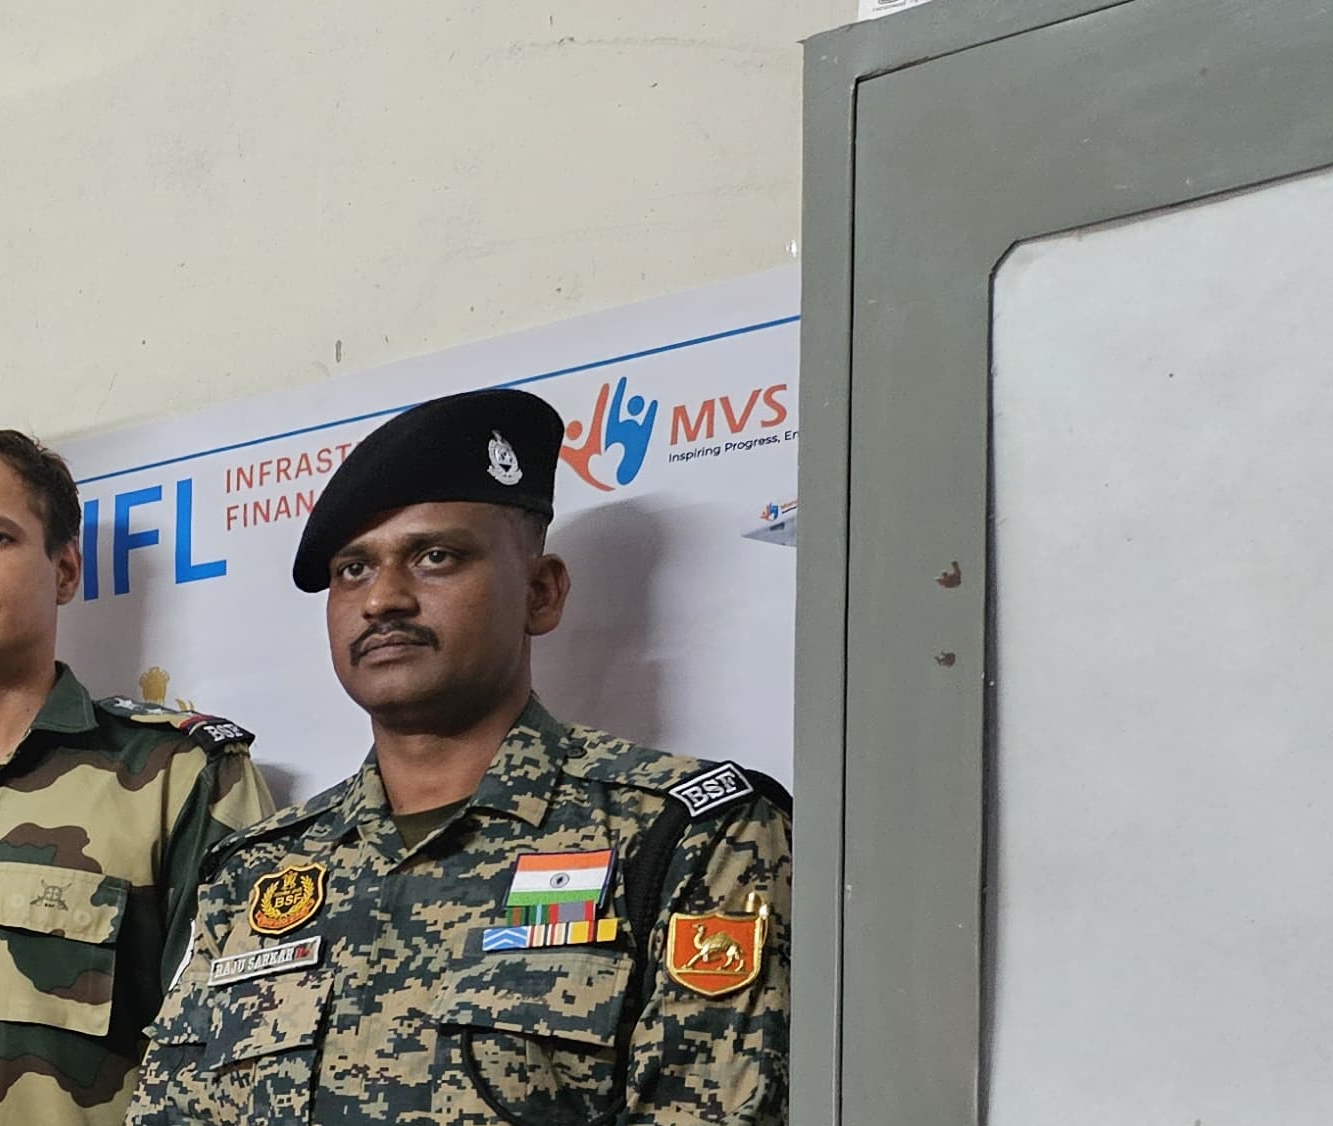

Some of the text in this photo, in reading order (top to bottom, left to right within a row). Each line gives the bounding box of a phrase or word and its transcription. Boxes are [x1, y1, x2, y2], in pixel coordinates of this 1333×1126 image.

[670, 383, 788, 446] MVS
[668, 445, 722, 464] Inspiring
[724, 433, 782, 453] Progress,
[83, 477, 227, 602] IFL
[203, 722, 244, 741] BSF
[680, 770, 737, 808] BSF
[274, 892, 302, 908] BSF
[214, 961, 245, 978] RAJU
[247, 947, 295, 970] SARKAR
